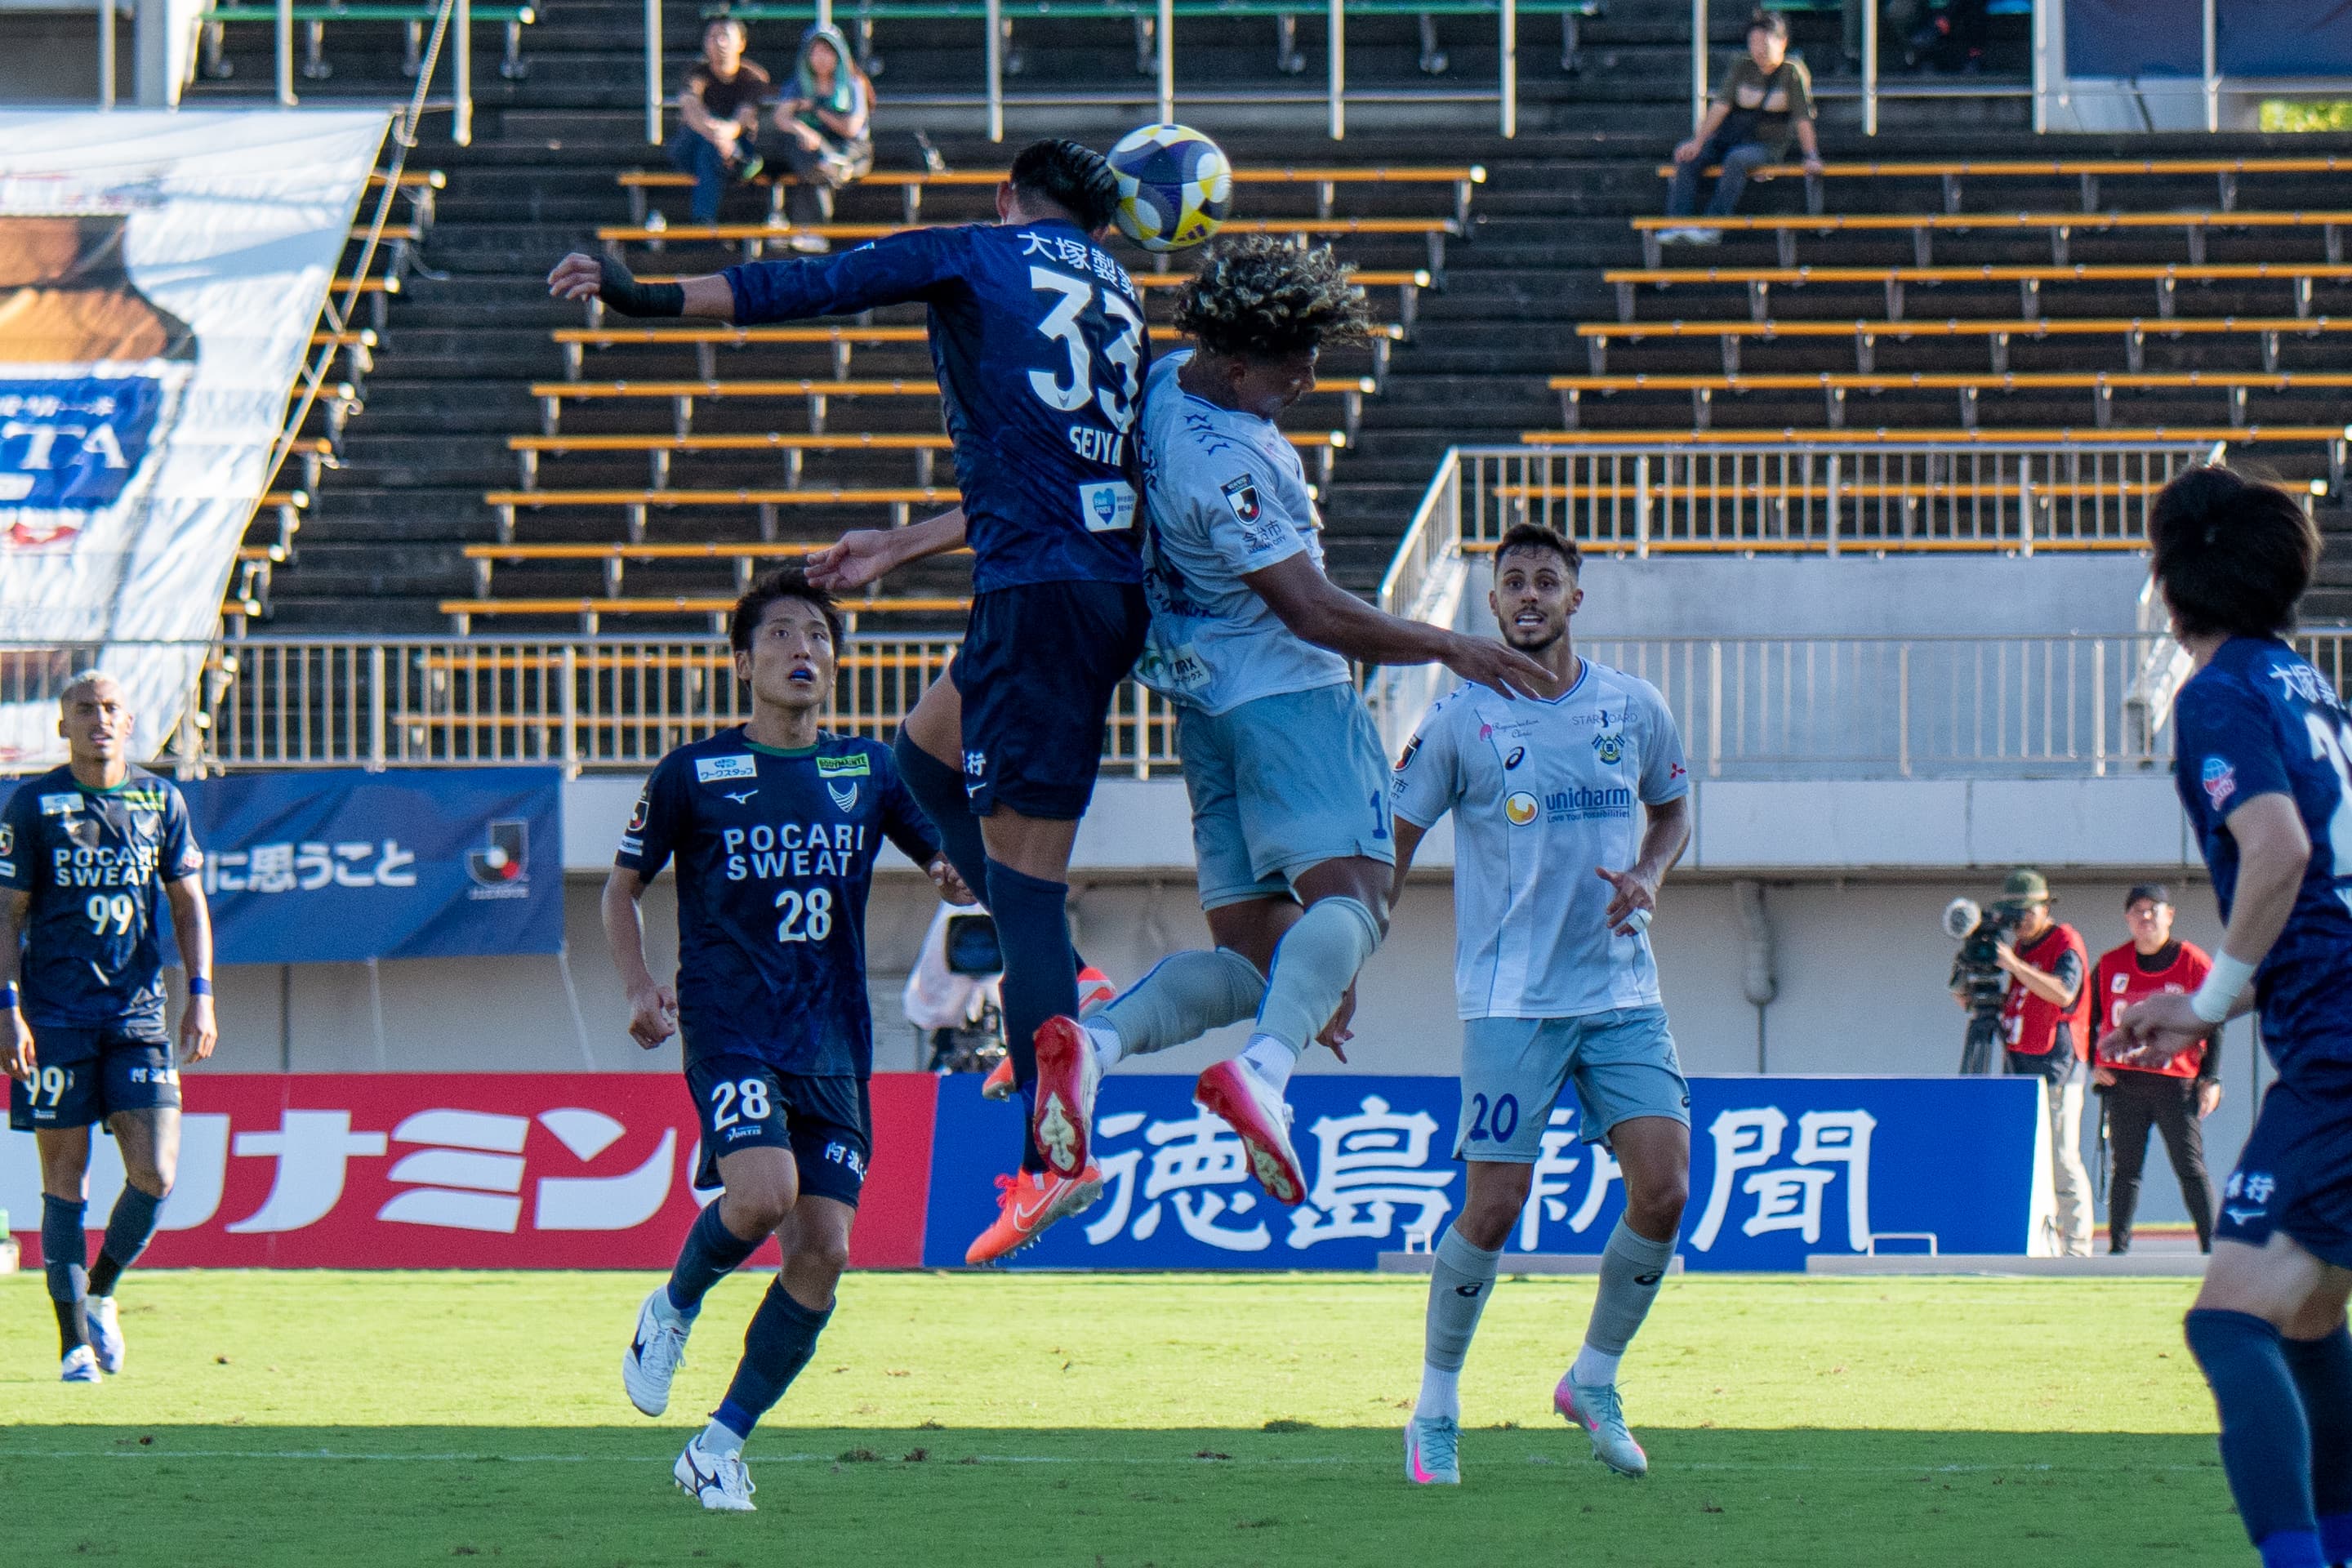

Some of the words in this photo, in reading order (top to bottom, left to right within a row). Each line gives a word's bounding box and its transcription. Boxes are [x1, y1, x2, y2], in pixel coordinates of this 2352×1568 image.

[1028, 265, 1143, 434] 33
[1546, 786, 1630, 811] unicharm
[54, 846, 160, 867] POCARI
[724, 823, 864, 854] POCARI
[56, 866, 153, 888] SWEAT
[206, 839, 417, 896] に思うこと
[727, 850, 853, 881] SWEAT
[87, 893, 134, 936] 99
[776, 888, 832, 942] 28
[24, 1065, 65, 1107] 99
[711, 1079, 771, 1132] 28
[1470, 1093, 1518, 1143] 20
